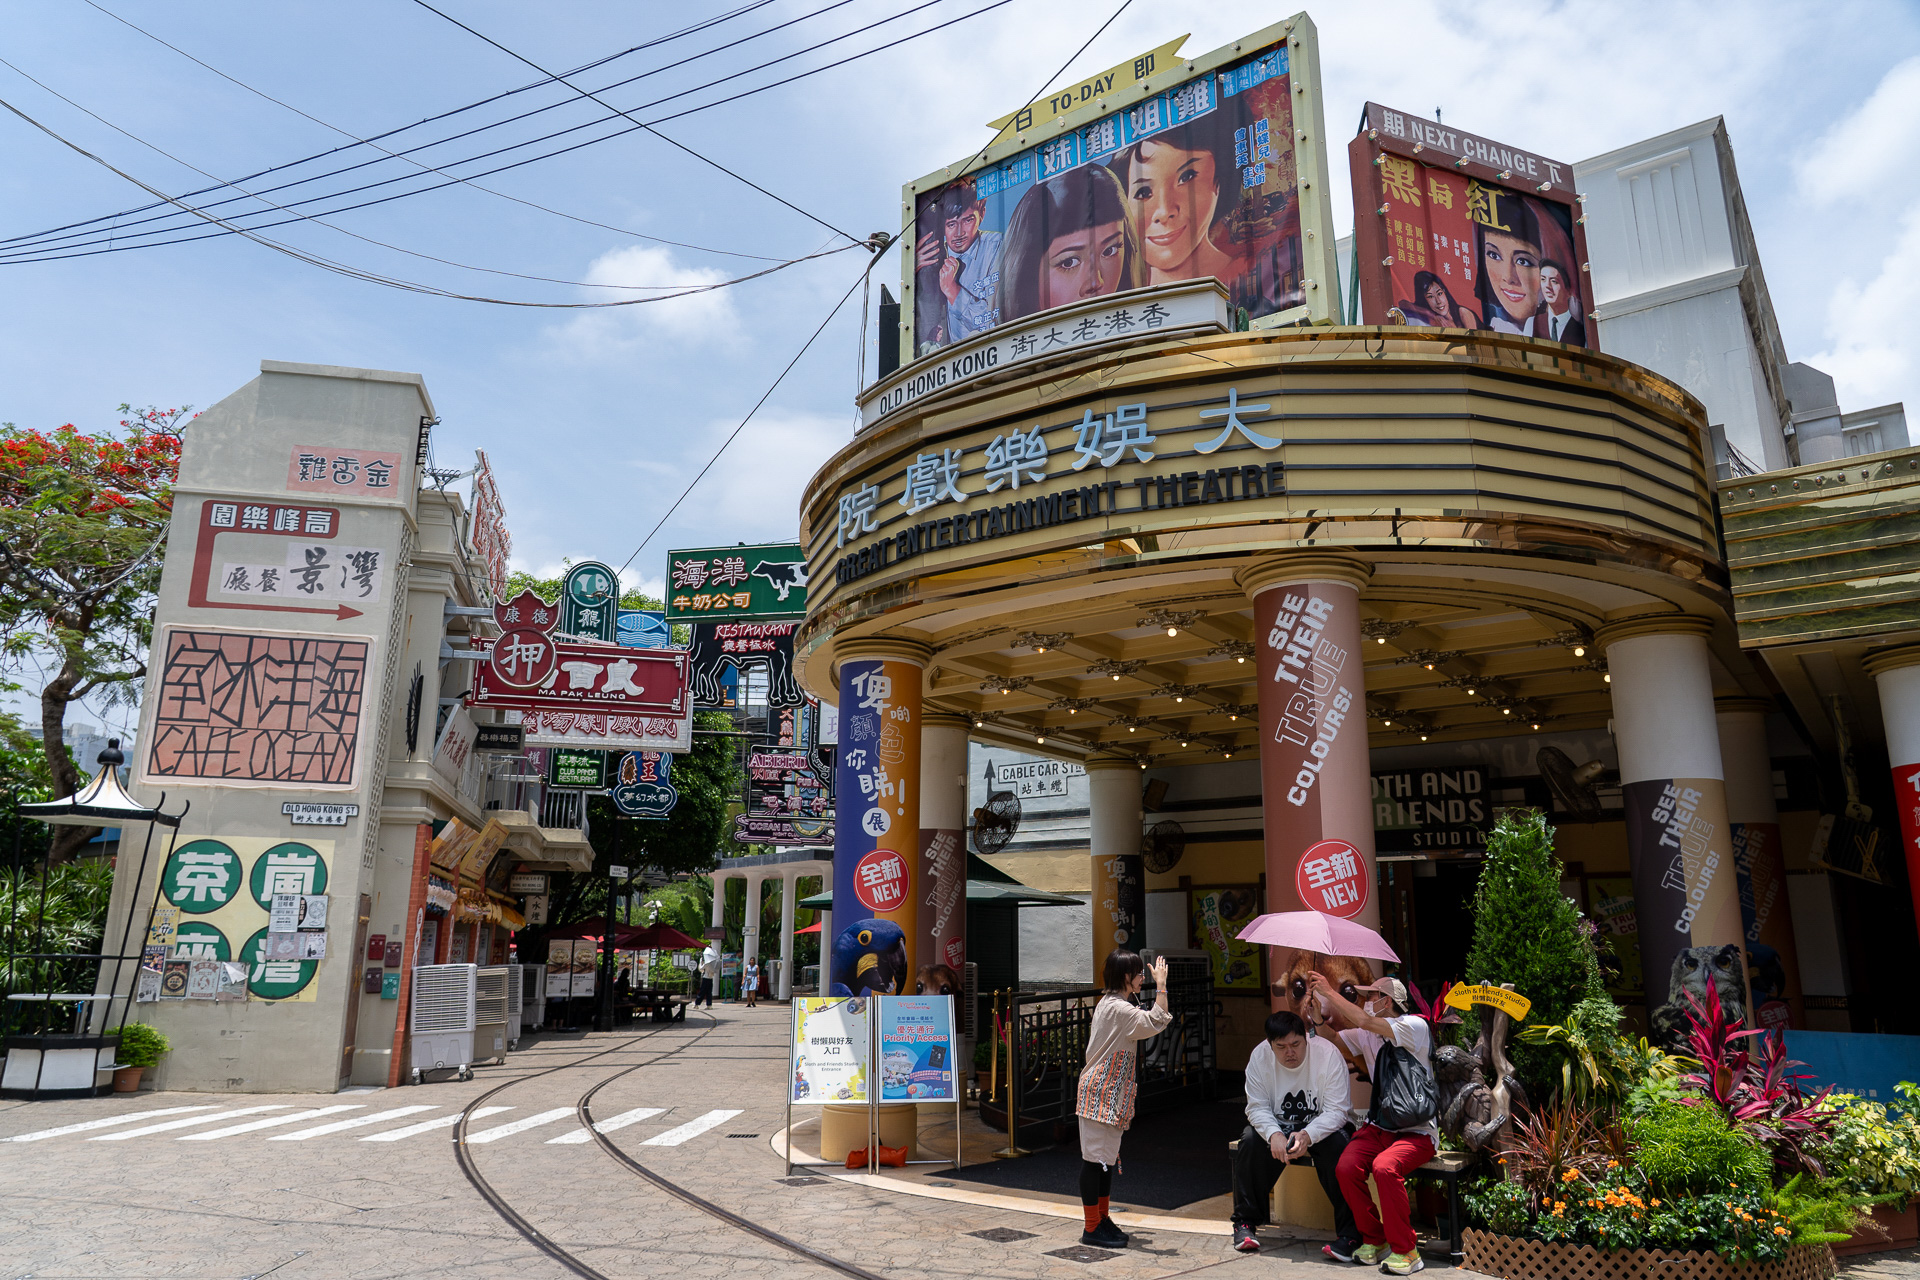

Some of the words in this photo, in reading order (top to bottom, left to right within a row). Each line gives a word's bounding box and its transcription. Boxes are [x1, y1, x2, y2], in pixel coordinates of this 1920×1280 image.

[1050, 72, 1116, 115] TO-DAY
[1411, 121, 1456, 151] NEXT
[1462, 138, 1538, 177] CHANGE
[880, 387, 903, 415] OLD
[907, 366, 947, 402] HONG
[953, 347, 998, 380] KONG
[836, 536, 887, 585] GREAT
[899, 480, 1122, 560] ENTERTAINMENT
[1135, 461, 1286, 510] THEATRE
[672, 557, 749, 590] 海洋
[672, 592, 752, 612] 牛奶公司
[714, 624, 795, 640] RESTAURANT
[1268, 591, 1306, 651] SEE
[500, 633, 547, 682] 押
[1273, 597, 1334, 685] THEIR
[588, 692, 627, 700] LEUNG
[1274, 637, 1348, 748] TRUE
[1286, 686, 1353, 807] COLOURS!
[558, 775, 599, 784] RESTAURANT
[577, 768, 598, 776] PANDA
[1002, 766, 1035, 781] CABLE
[1038, 764, 1059, 777] CAR
[1421, 770, 1482, 796] AND
[285, 804, 300, 814] OLD
[302, 805, 322, 814] HONG
[323, 805, 344, 815] KONG
[345, 807, 356, 816] ST
[1651, 784, 1682, 824] SEE
[1659, 786, 1703, 849] THEIR
[749, 822, 781, 831] OCEAN
[1413, 831, 1488, 847] STUDIO
[925, 832, 948, 860] SEE
[928, 835, 958, 878] THEIR
[1661, 816, 1715, 893] TRUE
[1735, 829, 1767, 878] THEIR
[861, 856, 901, 888] 全新
[926, 856, 962, 909] TRUE
[1304, 849, 1358, 889] 全新
[872, 881, 901, 904] NEW
[1321, 880, 1359, 910] NEW
[1674, 850, 1721, 934] COLOURS!
[1747, 878, 1780, 942] COLOURS!
[1454, 988, 1472, 997] Sloth
[1504, 993, 1526, 1008] Studio
[884, 1034, 915, 1044] Priority
[916, 1034, 949, 1042] Access
[896, 1025, 935, 1035] 優先通行
[823, 1046, 841, 1055] 入口
